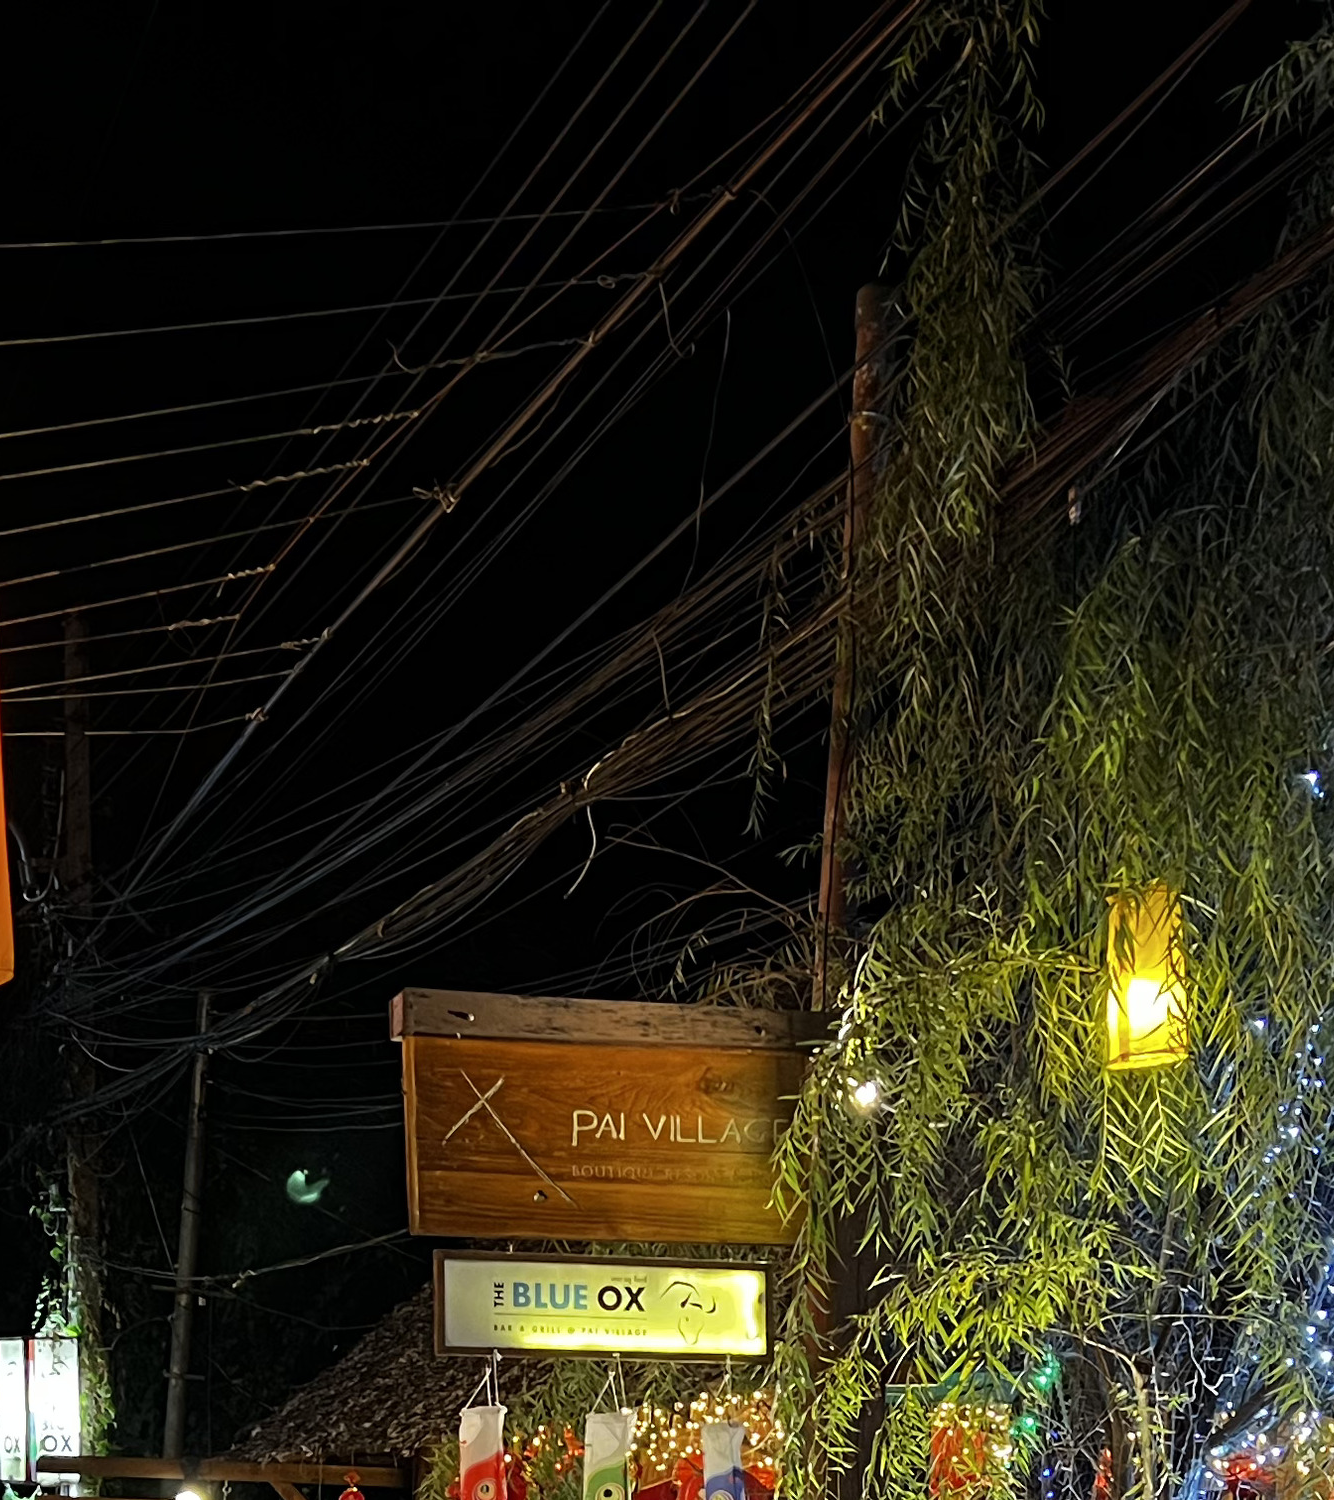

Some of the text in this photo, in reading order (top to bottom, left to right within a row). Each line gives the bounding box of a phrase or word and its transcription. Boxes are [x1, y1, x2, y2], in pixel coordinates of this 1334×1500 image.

[571, 1109, 626, 1147] PAI
[493, 1281, 505, 1308] THE
[512, 1281, 646, 1312] BLUE OX
[493, 1324, 513, 1332] BAR
[531, 1325, 561, 1334] GRILL
